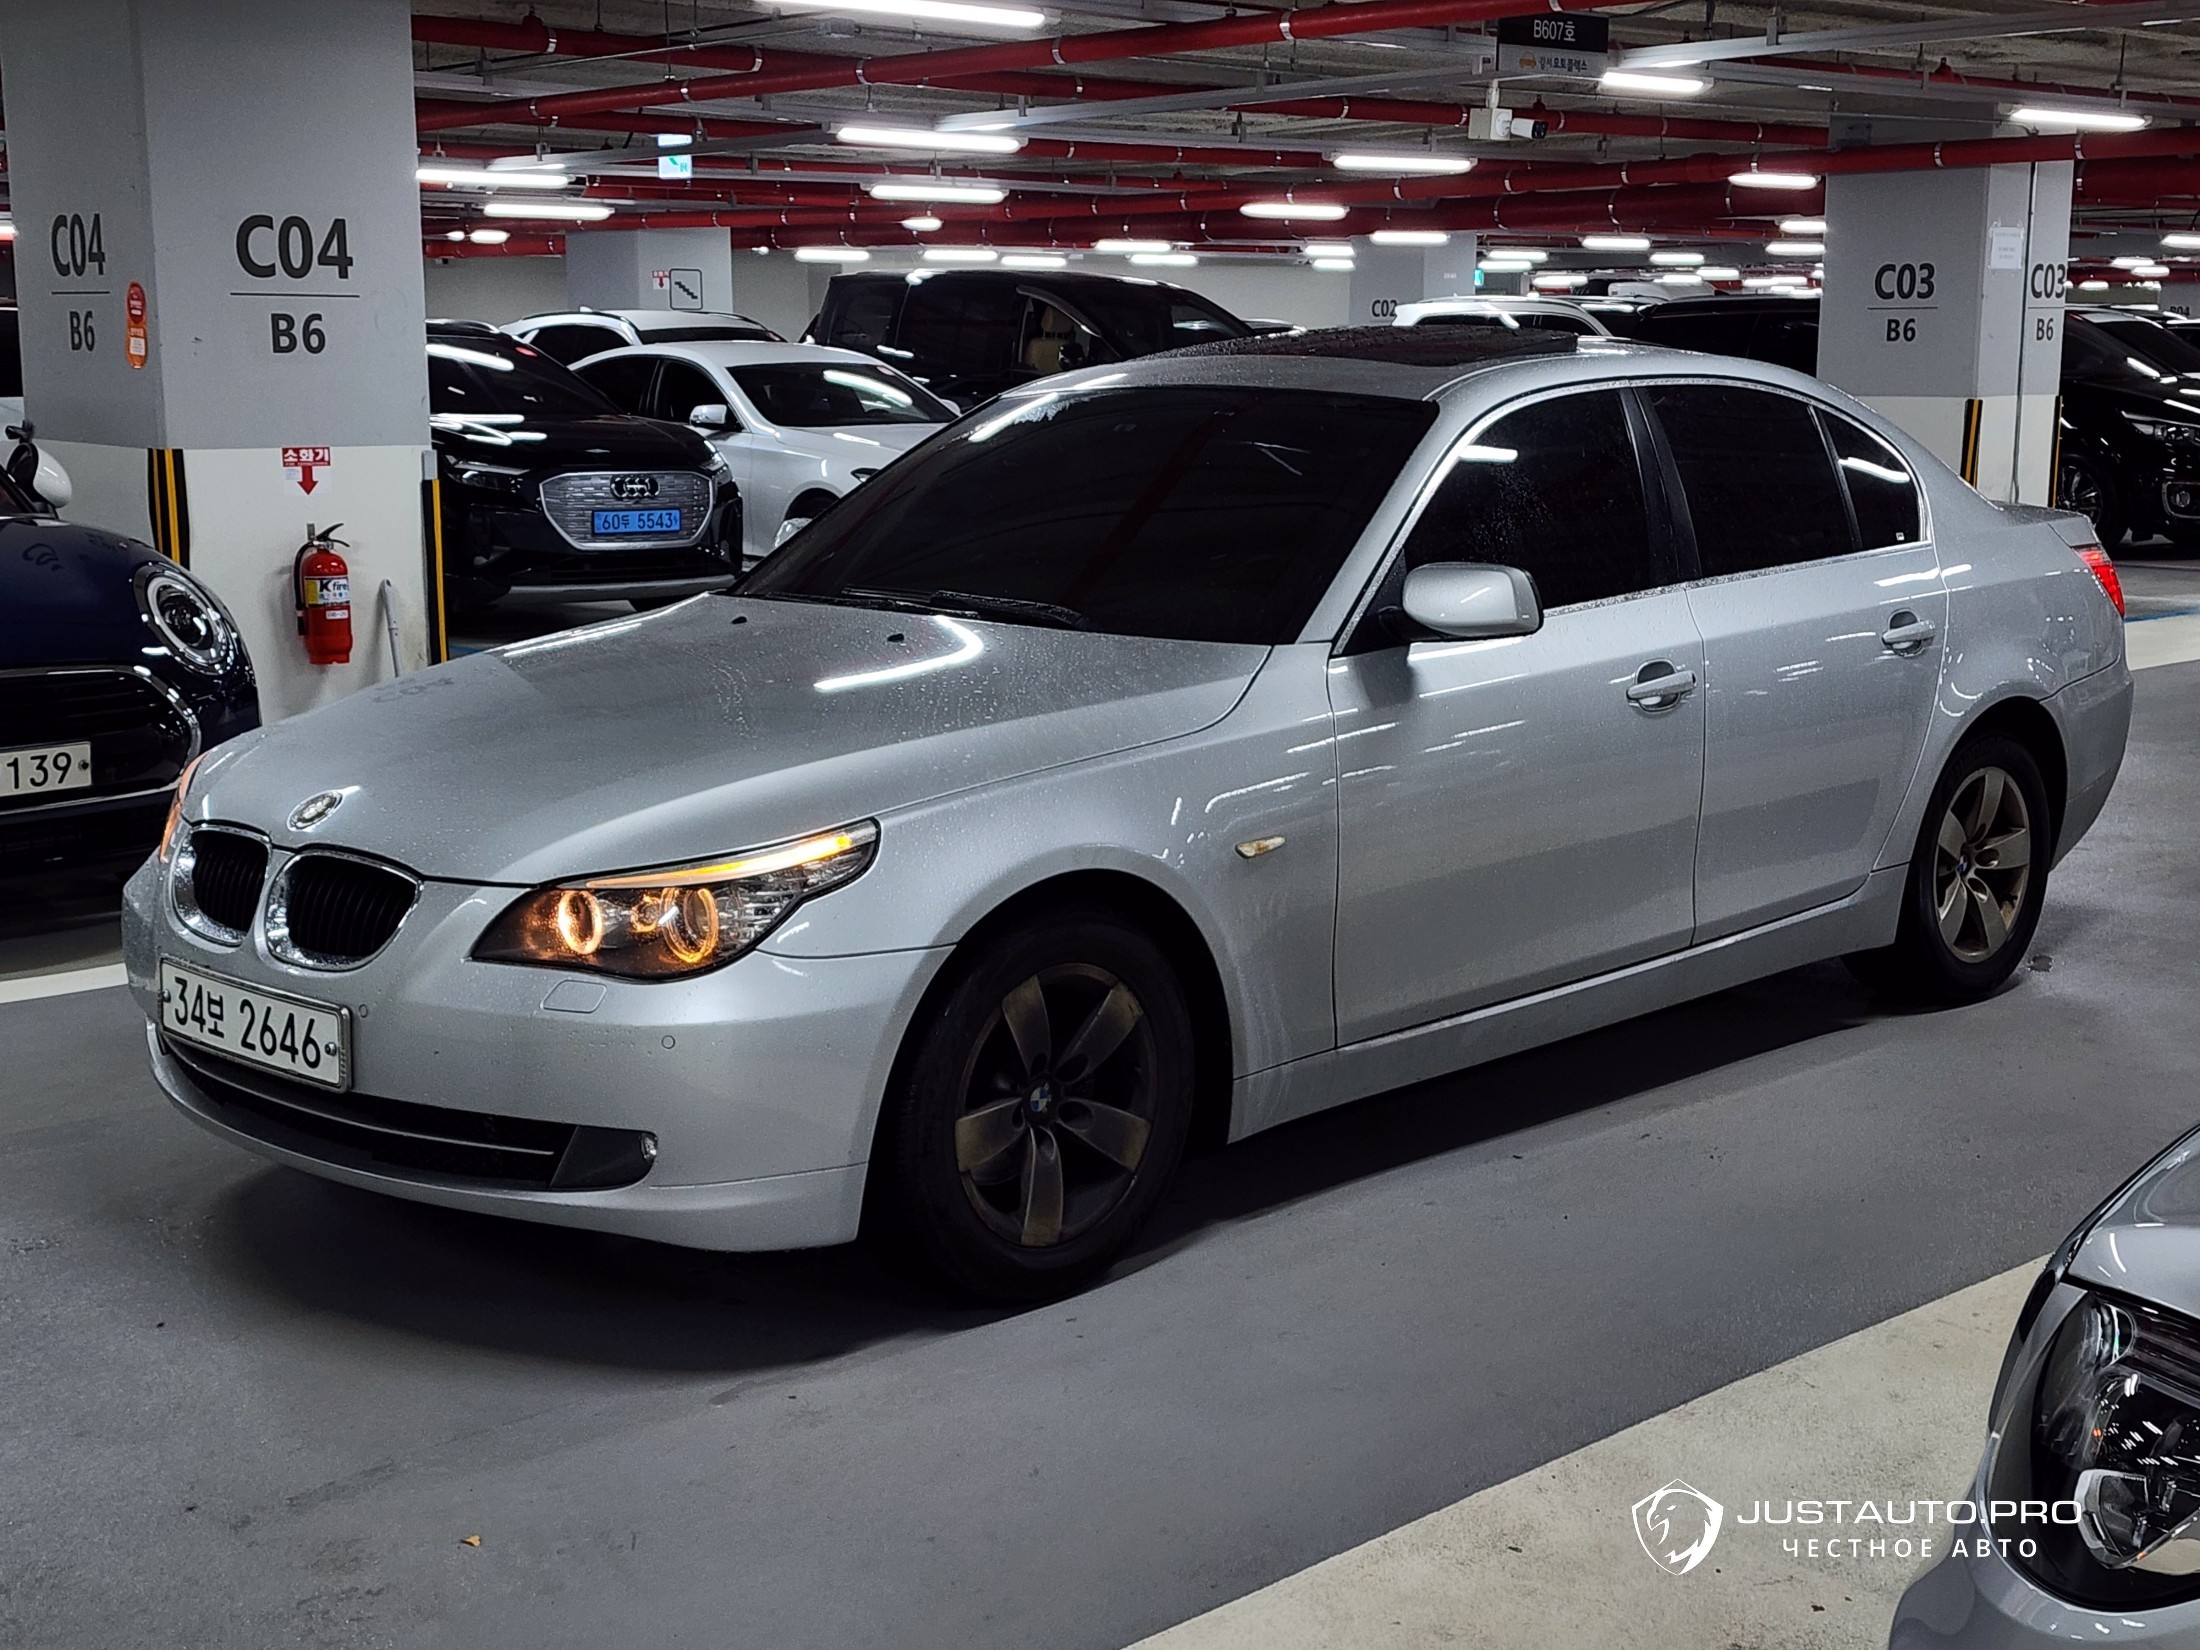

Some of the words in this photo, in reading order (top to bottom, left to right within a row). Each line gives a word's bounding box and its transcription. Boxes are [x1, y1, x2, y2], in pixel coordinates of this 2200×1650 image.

[1533, 20, 1576, 41] B607호
[51, 213, 106, 277] C04
[235, 214, 354, 279] C04
[1873, 263, 1936, 300] C03
[2030, 263, 2066, 299] C03
[1371, 300, 1398, 317] C02
[69, 311, 95, 351] B6
[270, 312, 326, 354] B6
[1885, 318, 1917, 342] B6
[2036, 318, 2054, 341] B6
[283, 449, 329, 462] 소화기
[637, 512, 673, 529] 5543
[6, 752, 72, 789] 139
[174, 976, 225, 1039] 34보
[239, 998, 321, 1069] 2646
